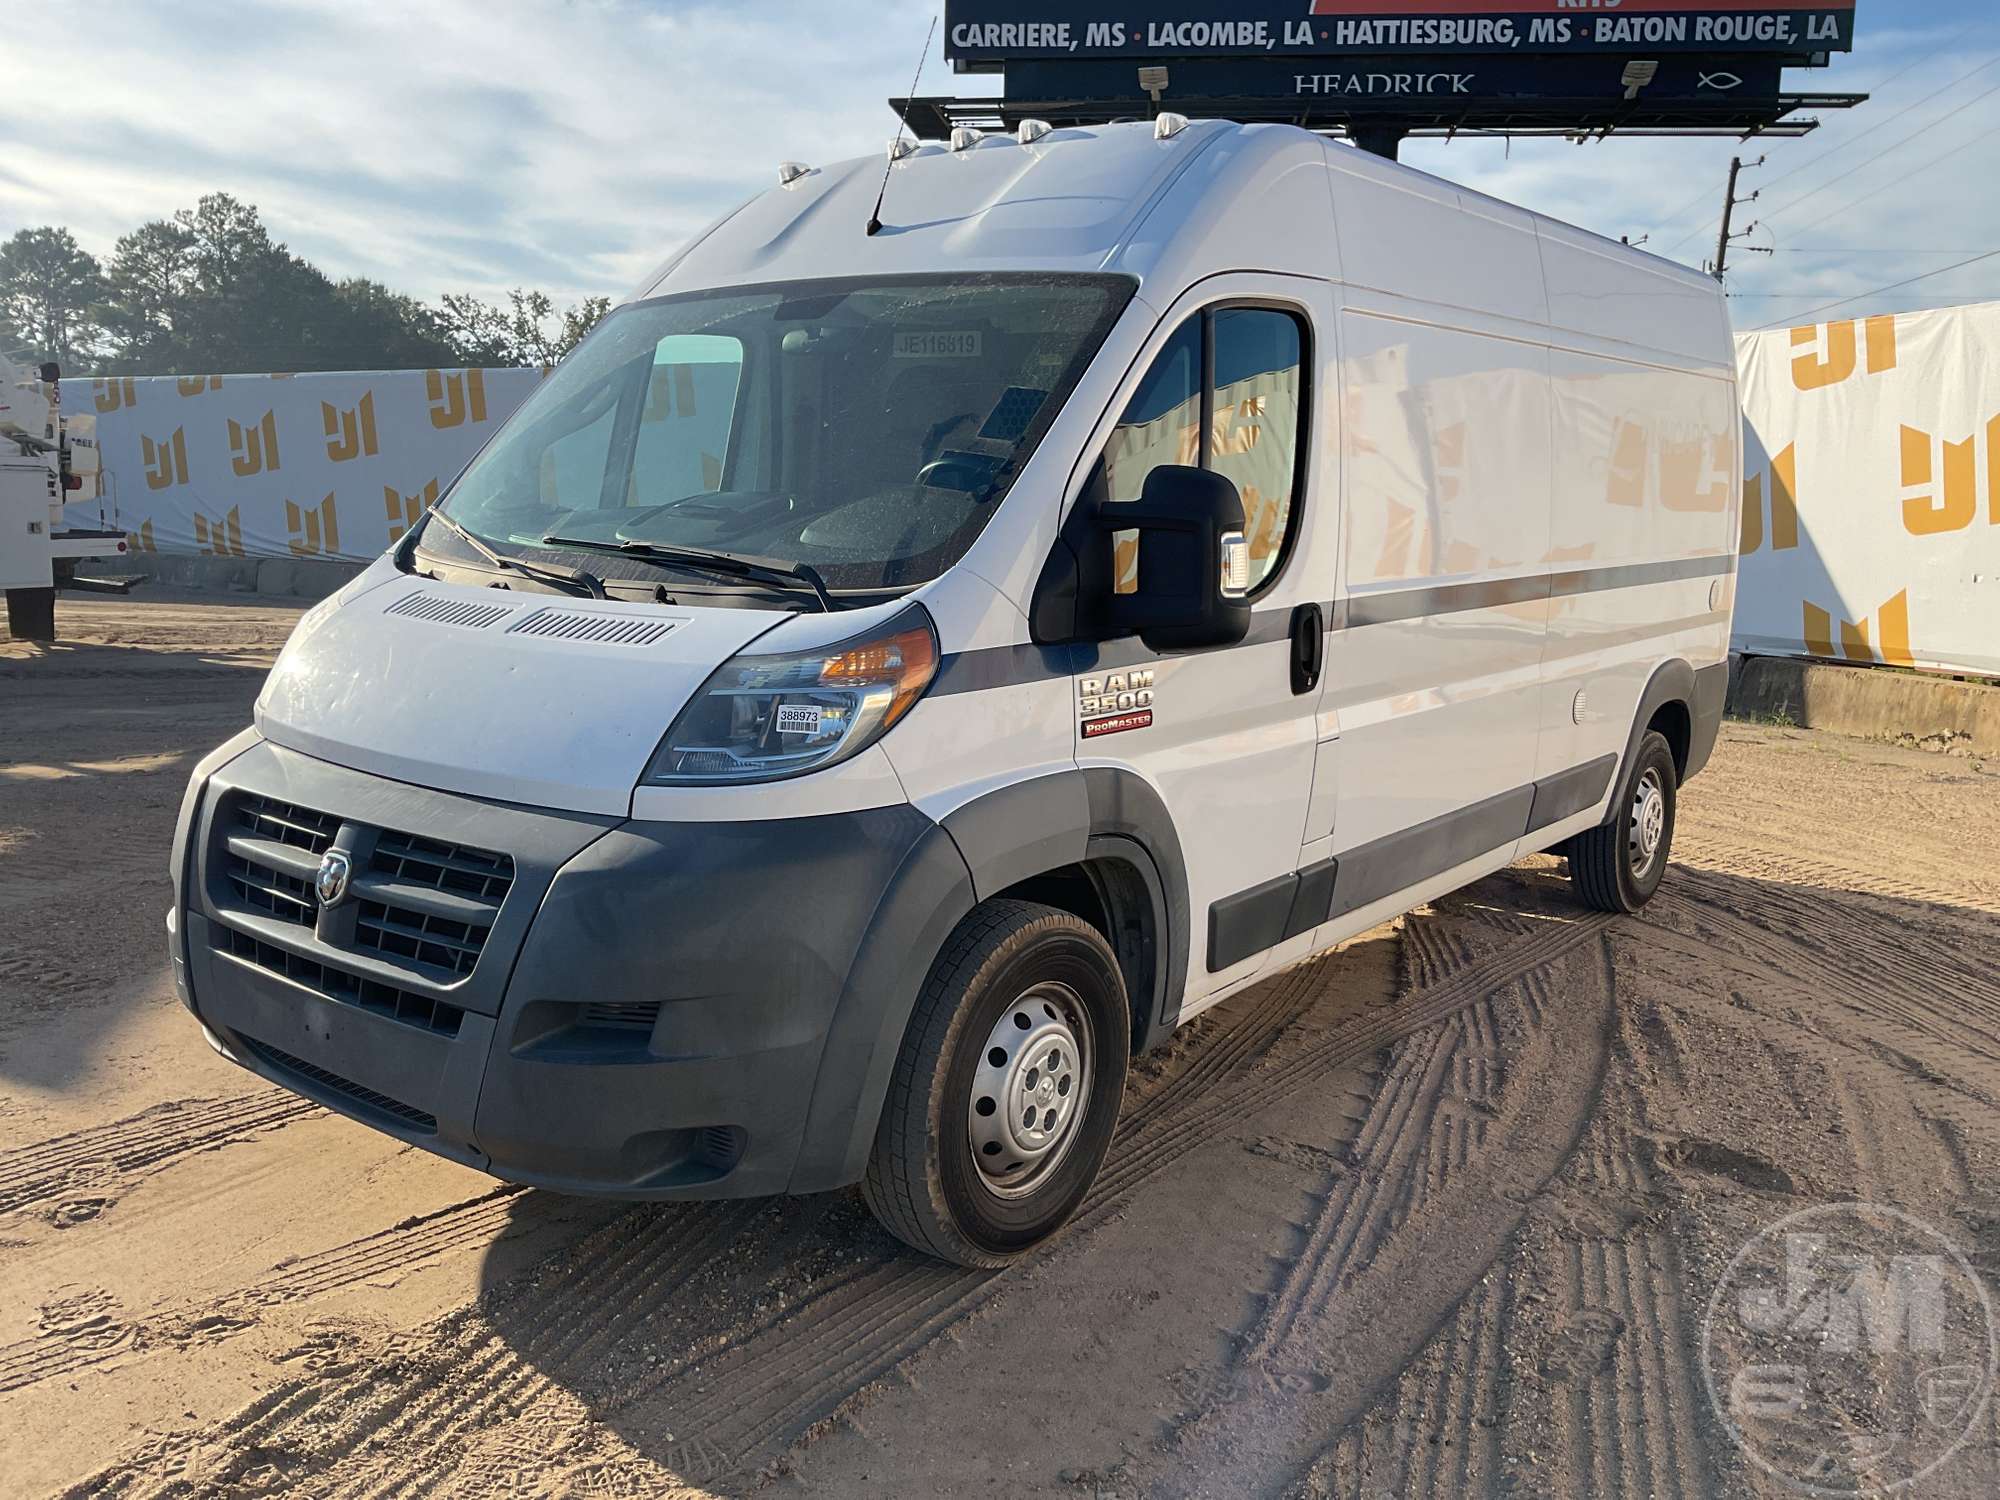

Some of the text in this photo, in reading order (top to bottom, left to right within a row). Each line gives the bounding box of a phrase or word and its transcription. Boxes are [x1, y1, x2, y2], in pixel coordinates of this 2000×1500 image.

[951, 14, 1840, 51] CARRIERE, MS LACOMBE, LA HATTIESBURG, MS BATON ROUGE, LA
[1293, 73, 1476, 94] HEADRICK
[1079, 669, 1154, 698] RAM
[780, 710, 819, 722] 388973
[1080, 688, 1154, 718] 3500
